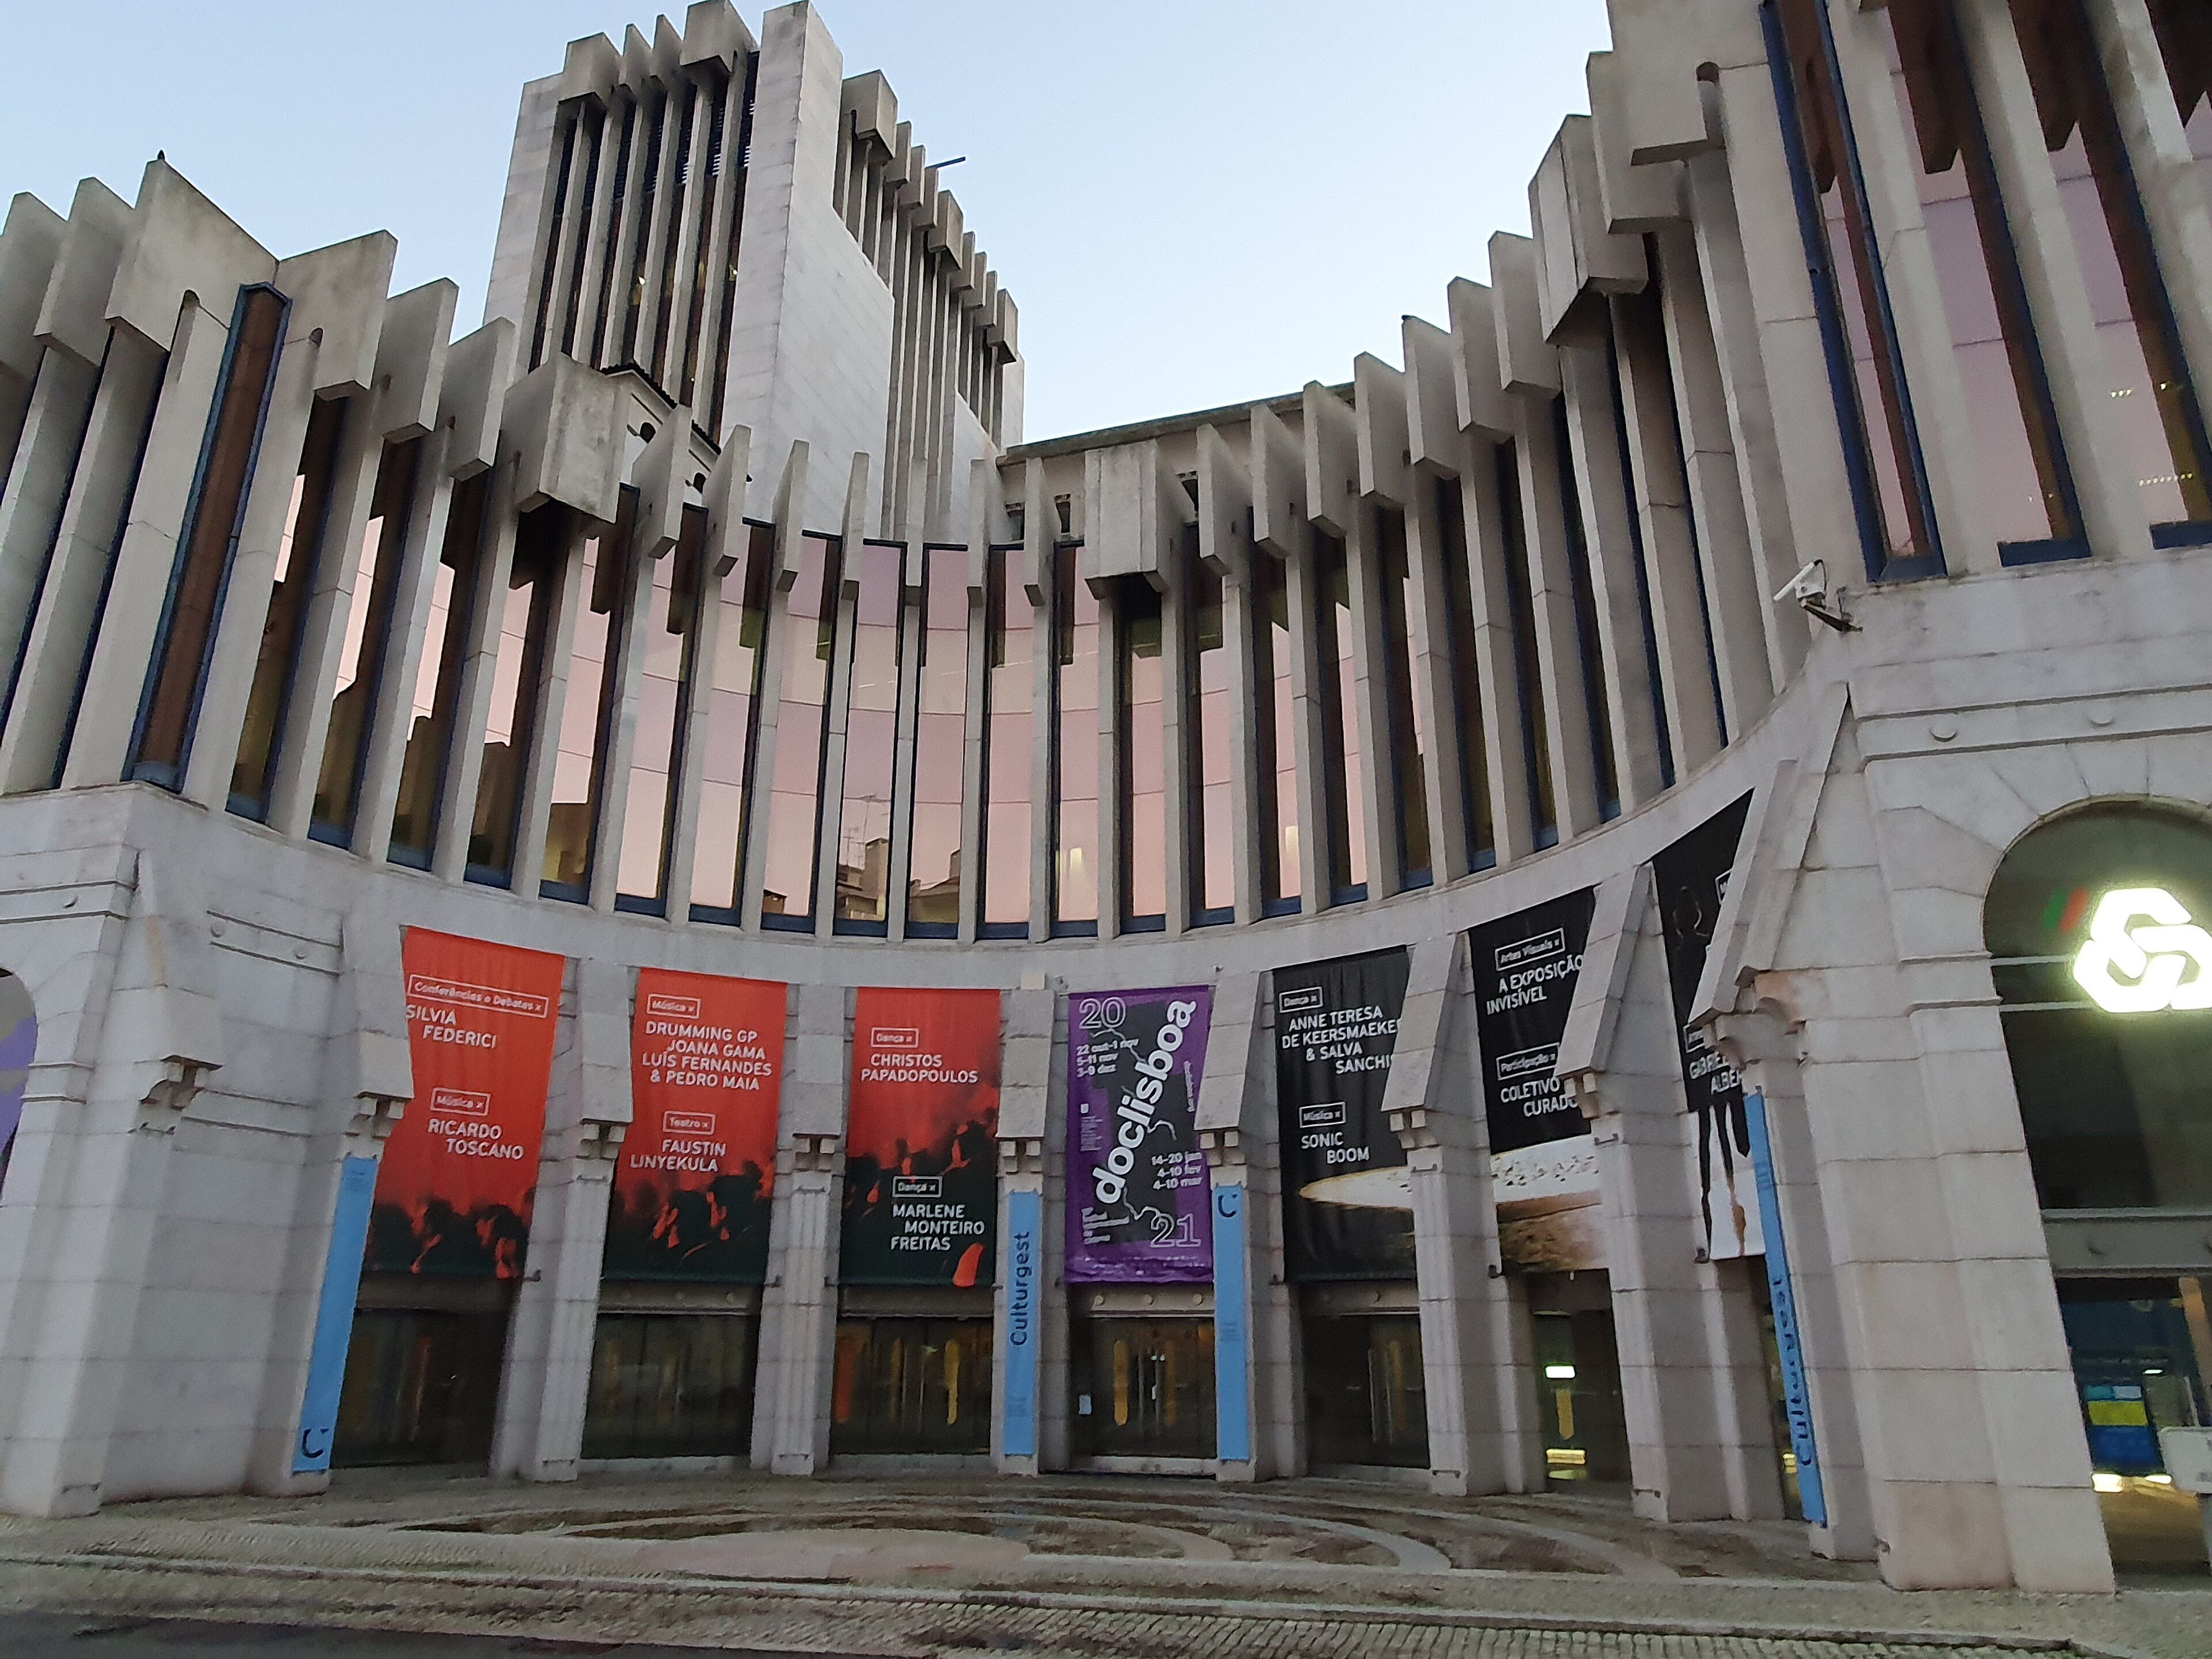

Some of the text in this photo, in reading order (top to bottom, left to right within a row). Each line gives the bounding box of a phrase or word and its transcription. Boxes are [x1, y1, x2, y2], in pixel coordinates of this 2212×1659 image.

[1499, 954, 1584, 994] A EXPOSIÇÃO
[494, 995, 533, 1010] Debates
[1486, 985, 1548, 1015] INVISÍVEL
[405, 1005, 457, 1025] SILVIA
[1079, 997, 1126, 1029] 20
[1289, 1006, 1383, 1032] ANNE TERESA
[423, 1025, 497, 1048] FEDERICI
[646, 1021, 758, 1044] DRUMMING GP
[1282, 1019, 1400, 1049] DE KEERSMAEKE
[666, 1039, 766, 1060] JOANA GAMA
[1306, 1041, 1363, 1061] & SALVA
[642, 1051, 772, 1077] LUÍS FERNANDES
[870, 1054, 942, 1067] CHRISTOS
[650, 1069, 760, 1090] & PEDRO MAIA
[861, 1068, 978, 1084] PAPADOPOULOS
[1501, 1077, 1560, 1103] COLETIVO
[1092, 1001, 1196, 1204] doclisboa
[427, 1119, 502, 1139] RICARDO
[446, 1138, 524, 1160] TOSCANO
[662, 1139, 726, 1157] FAUSTIN
[1301, 1132, 1343, 1149] SONIC
[630, 1154, 718, 1172] LINYEKULA
[1327, 1146, 1369, 1164] BOOM
[893, 1203, 965, 1218] MARLENE
[905, 1219, 985, 1235] MONTEIRO
[1150, 1213, 1202, 1248] 21
[891, 1236, 951, 1251] FREITAS
[1010, 1231, 1032, 1346] Culturgest
